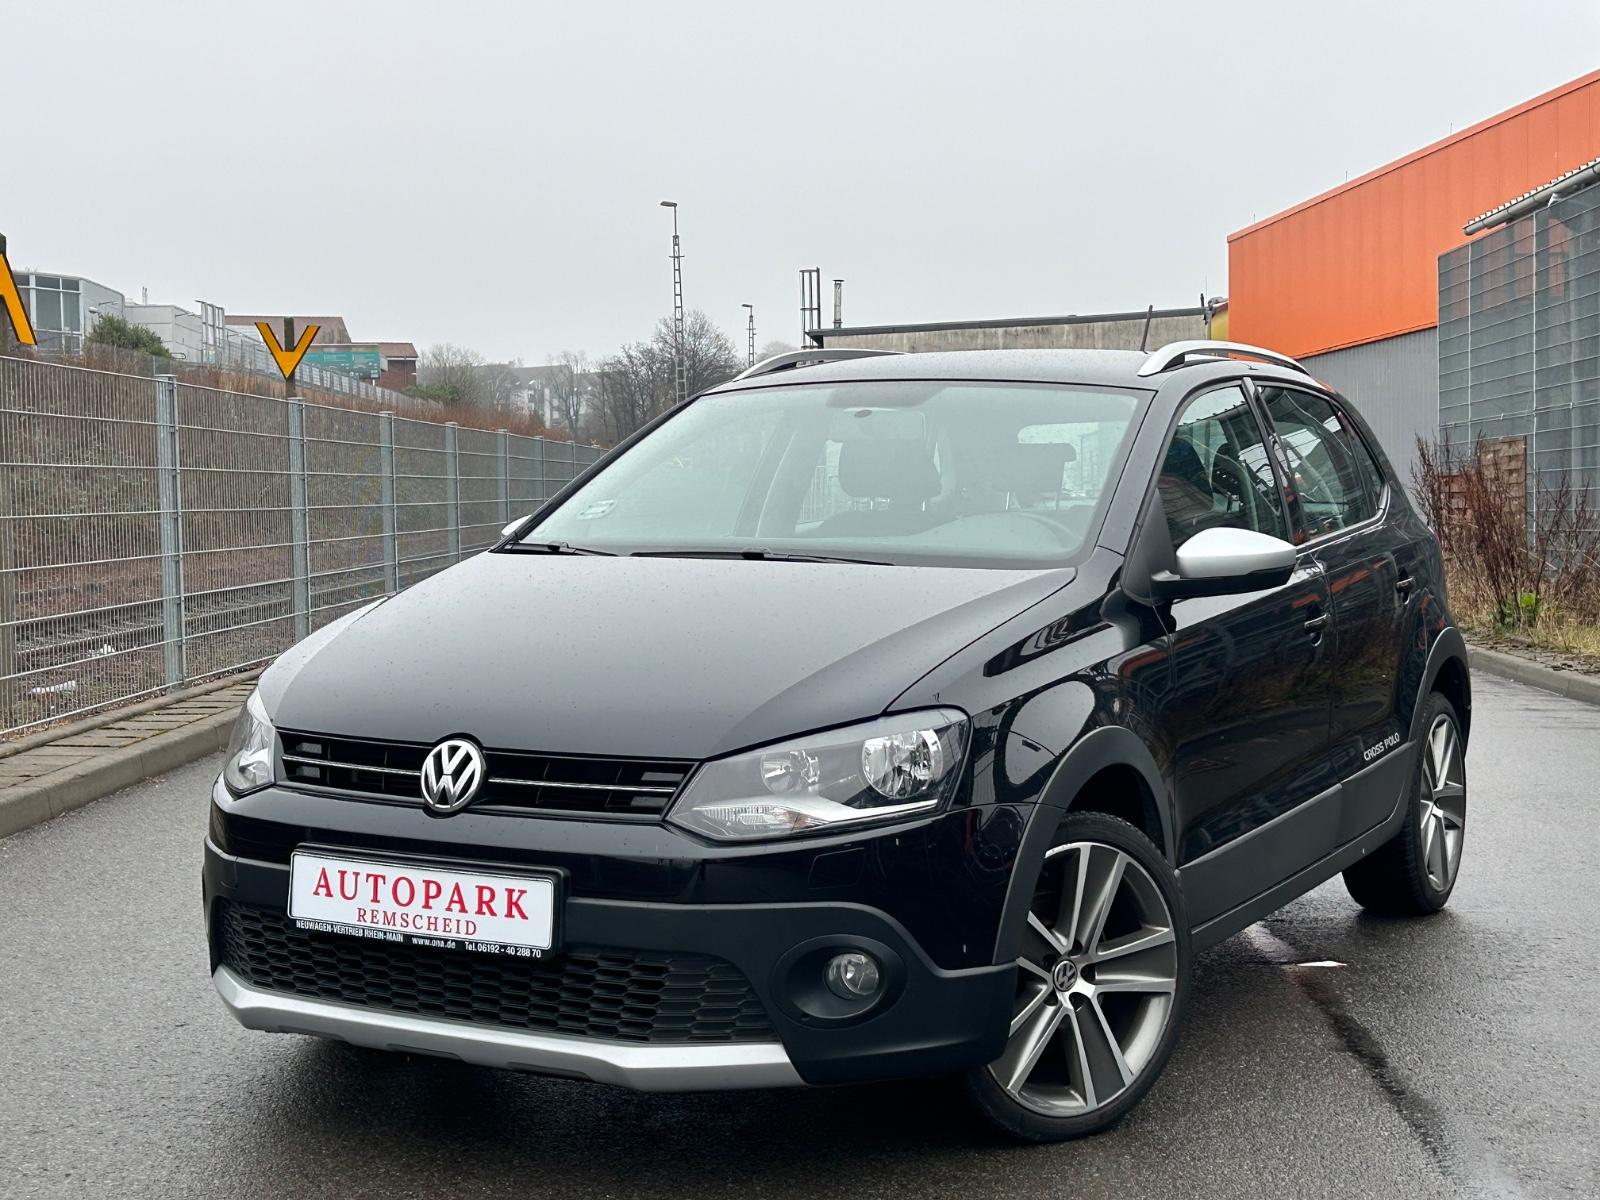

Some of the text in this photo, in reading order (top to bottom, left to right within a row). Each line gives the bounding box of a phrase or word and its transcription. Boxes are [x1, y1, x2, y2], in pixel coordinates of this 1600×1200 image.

[1363, 732, 1400, 761] CROSS POLO
[312, 866, 529, 920] AUTOPARK
[296, 919, 364, 937] NEUWAGEN-VERTRIEB
[364, 928, 404, 942] RHEIN-MAIN
[505, 946, 516, 955] 40
[531, 949, 541, 958] 70
[356, 907, 477, 936] REMSCHEID
